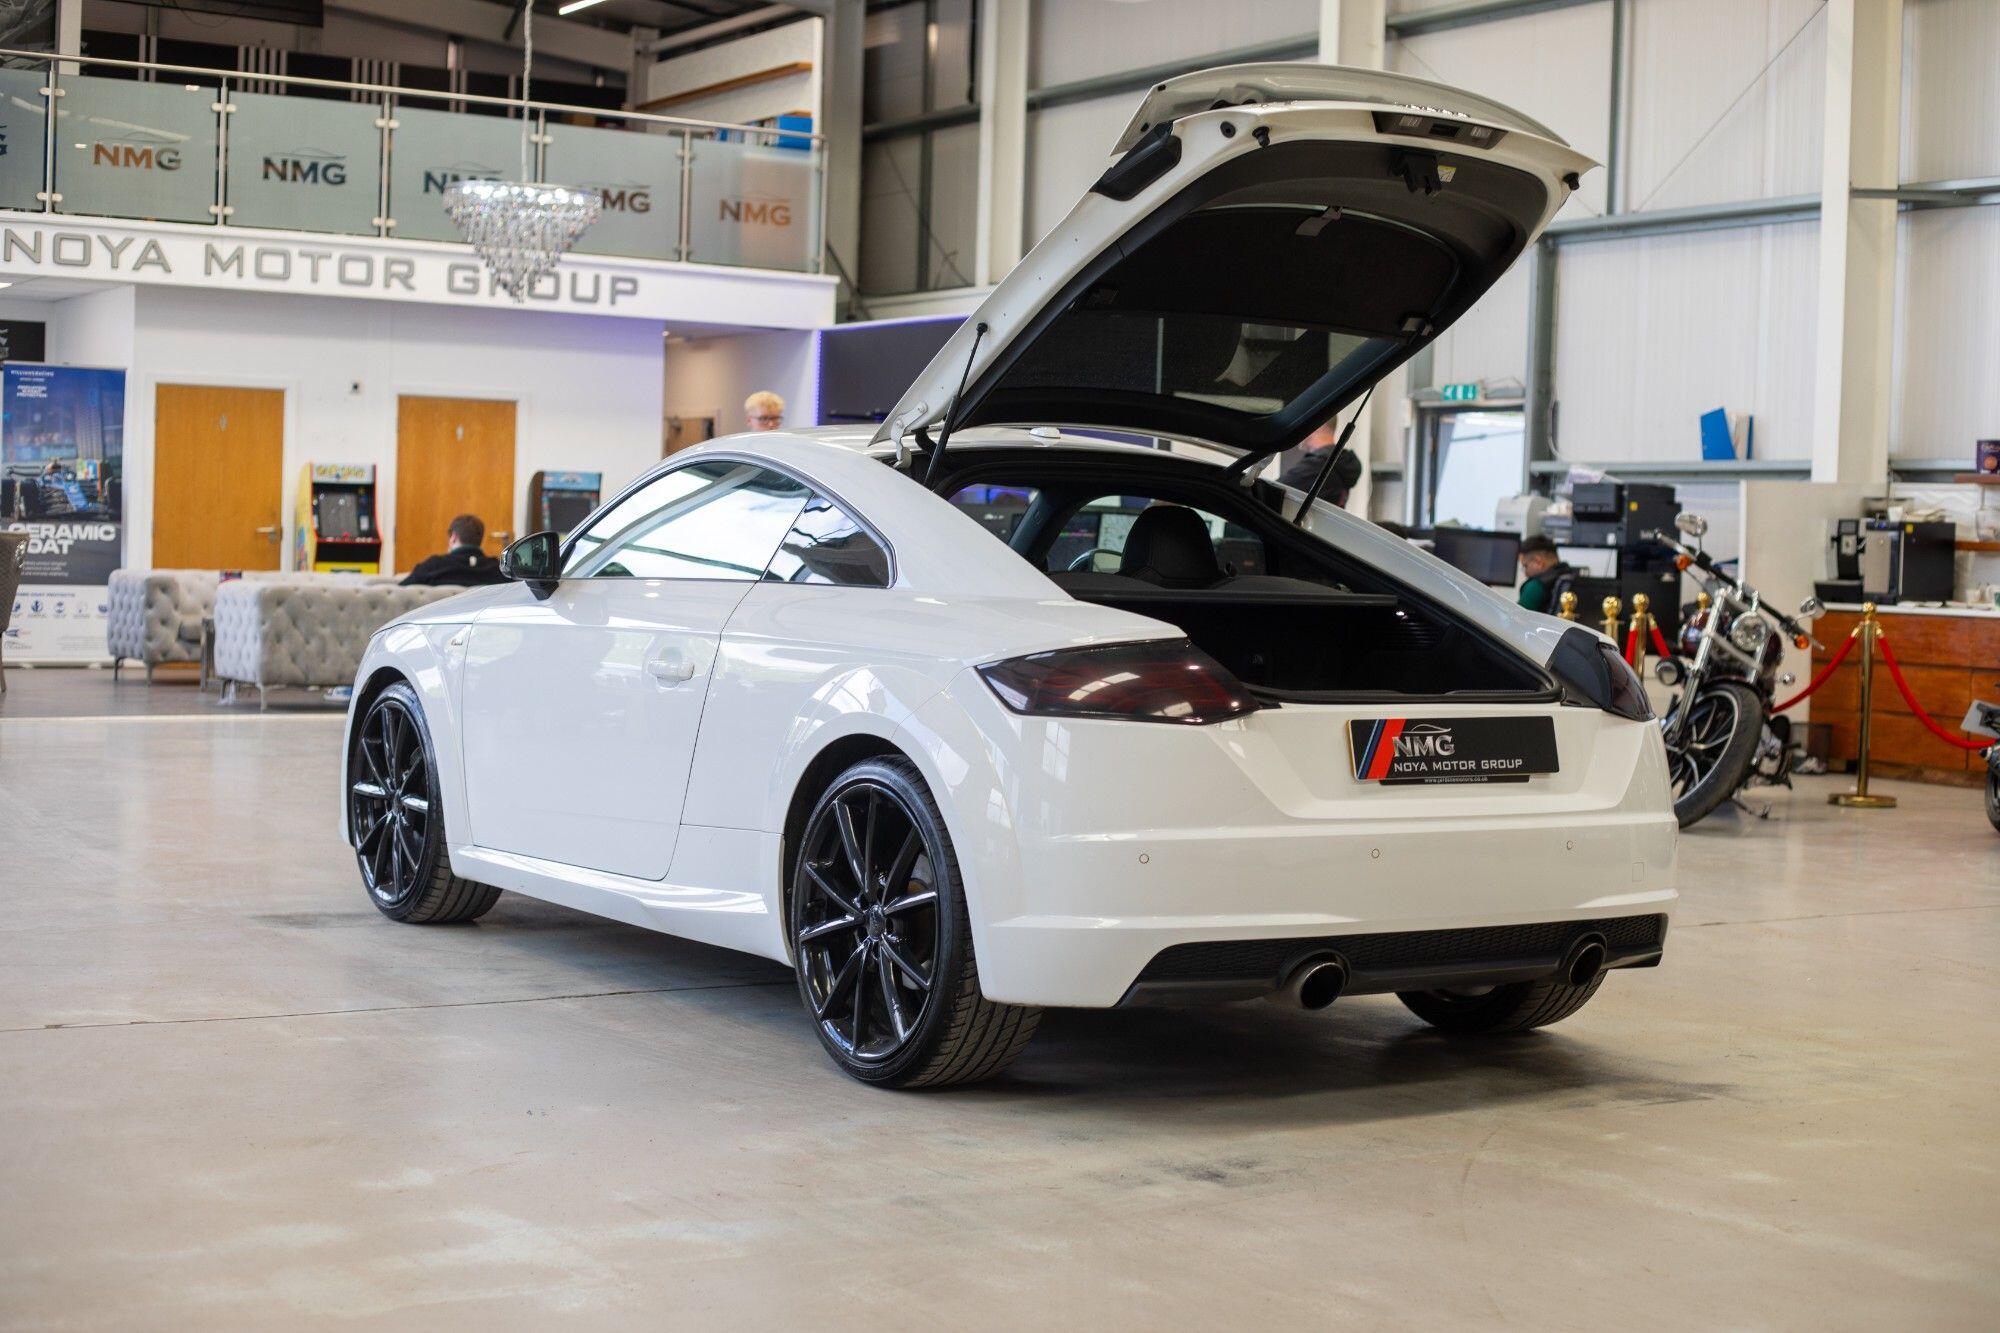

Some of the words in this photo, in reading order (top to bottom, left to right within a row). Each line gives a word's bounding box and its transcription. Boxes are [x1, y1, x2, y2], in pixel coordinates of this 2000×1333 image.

[93, 143, 182, 171] NMG
[262, 156, 347, 186] NMG
[602, 189, 650, 213] MG
[719, 200, 791, 227] NMG
[3, 228, 172, 273] NOYA
[204, 242, 416, 290] MOTOR
[26, 539, 75, 555] OAT
[1392, 735, 1455, 758] NMG
[1394, 761, 1428, 772] NOYA
[1432, 760, 1477, 771] MOTOR
[1481, 758, 1523, 770] GROUP
